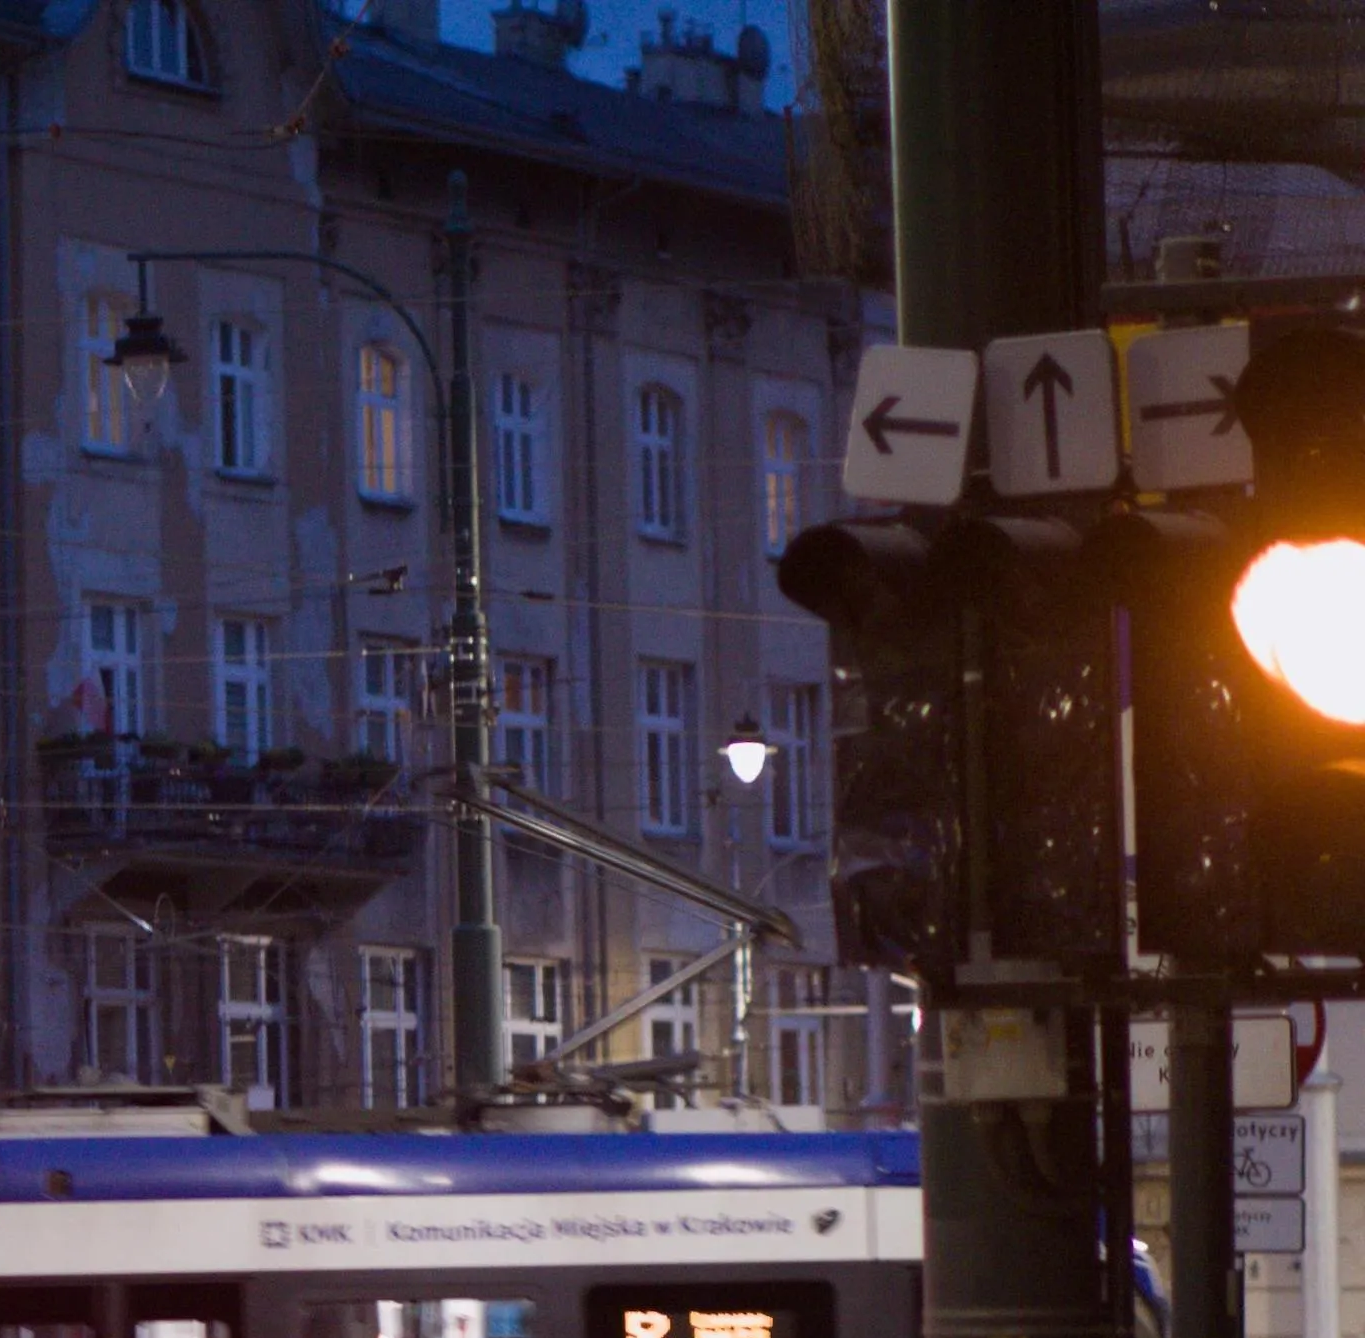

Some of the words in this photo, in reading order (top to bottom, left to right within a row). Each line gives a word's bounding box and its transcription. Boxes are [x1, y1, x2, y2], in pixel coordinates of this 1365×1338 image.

[1233, 1122, 1299, 1144] otyczy
[386, 1217, 546, 1244] Komunikacja
[676, 1212, 794, 1236] Krakowie
